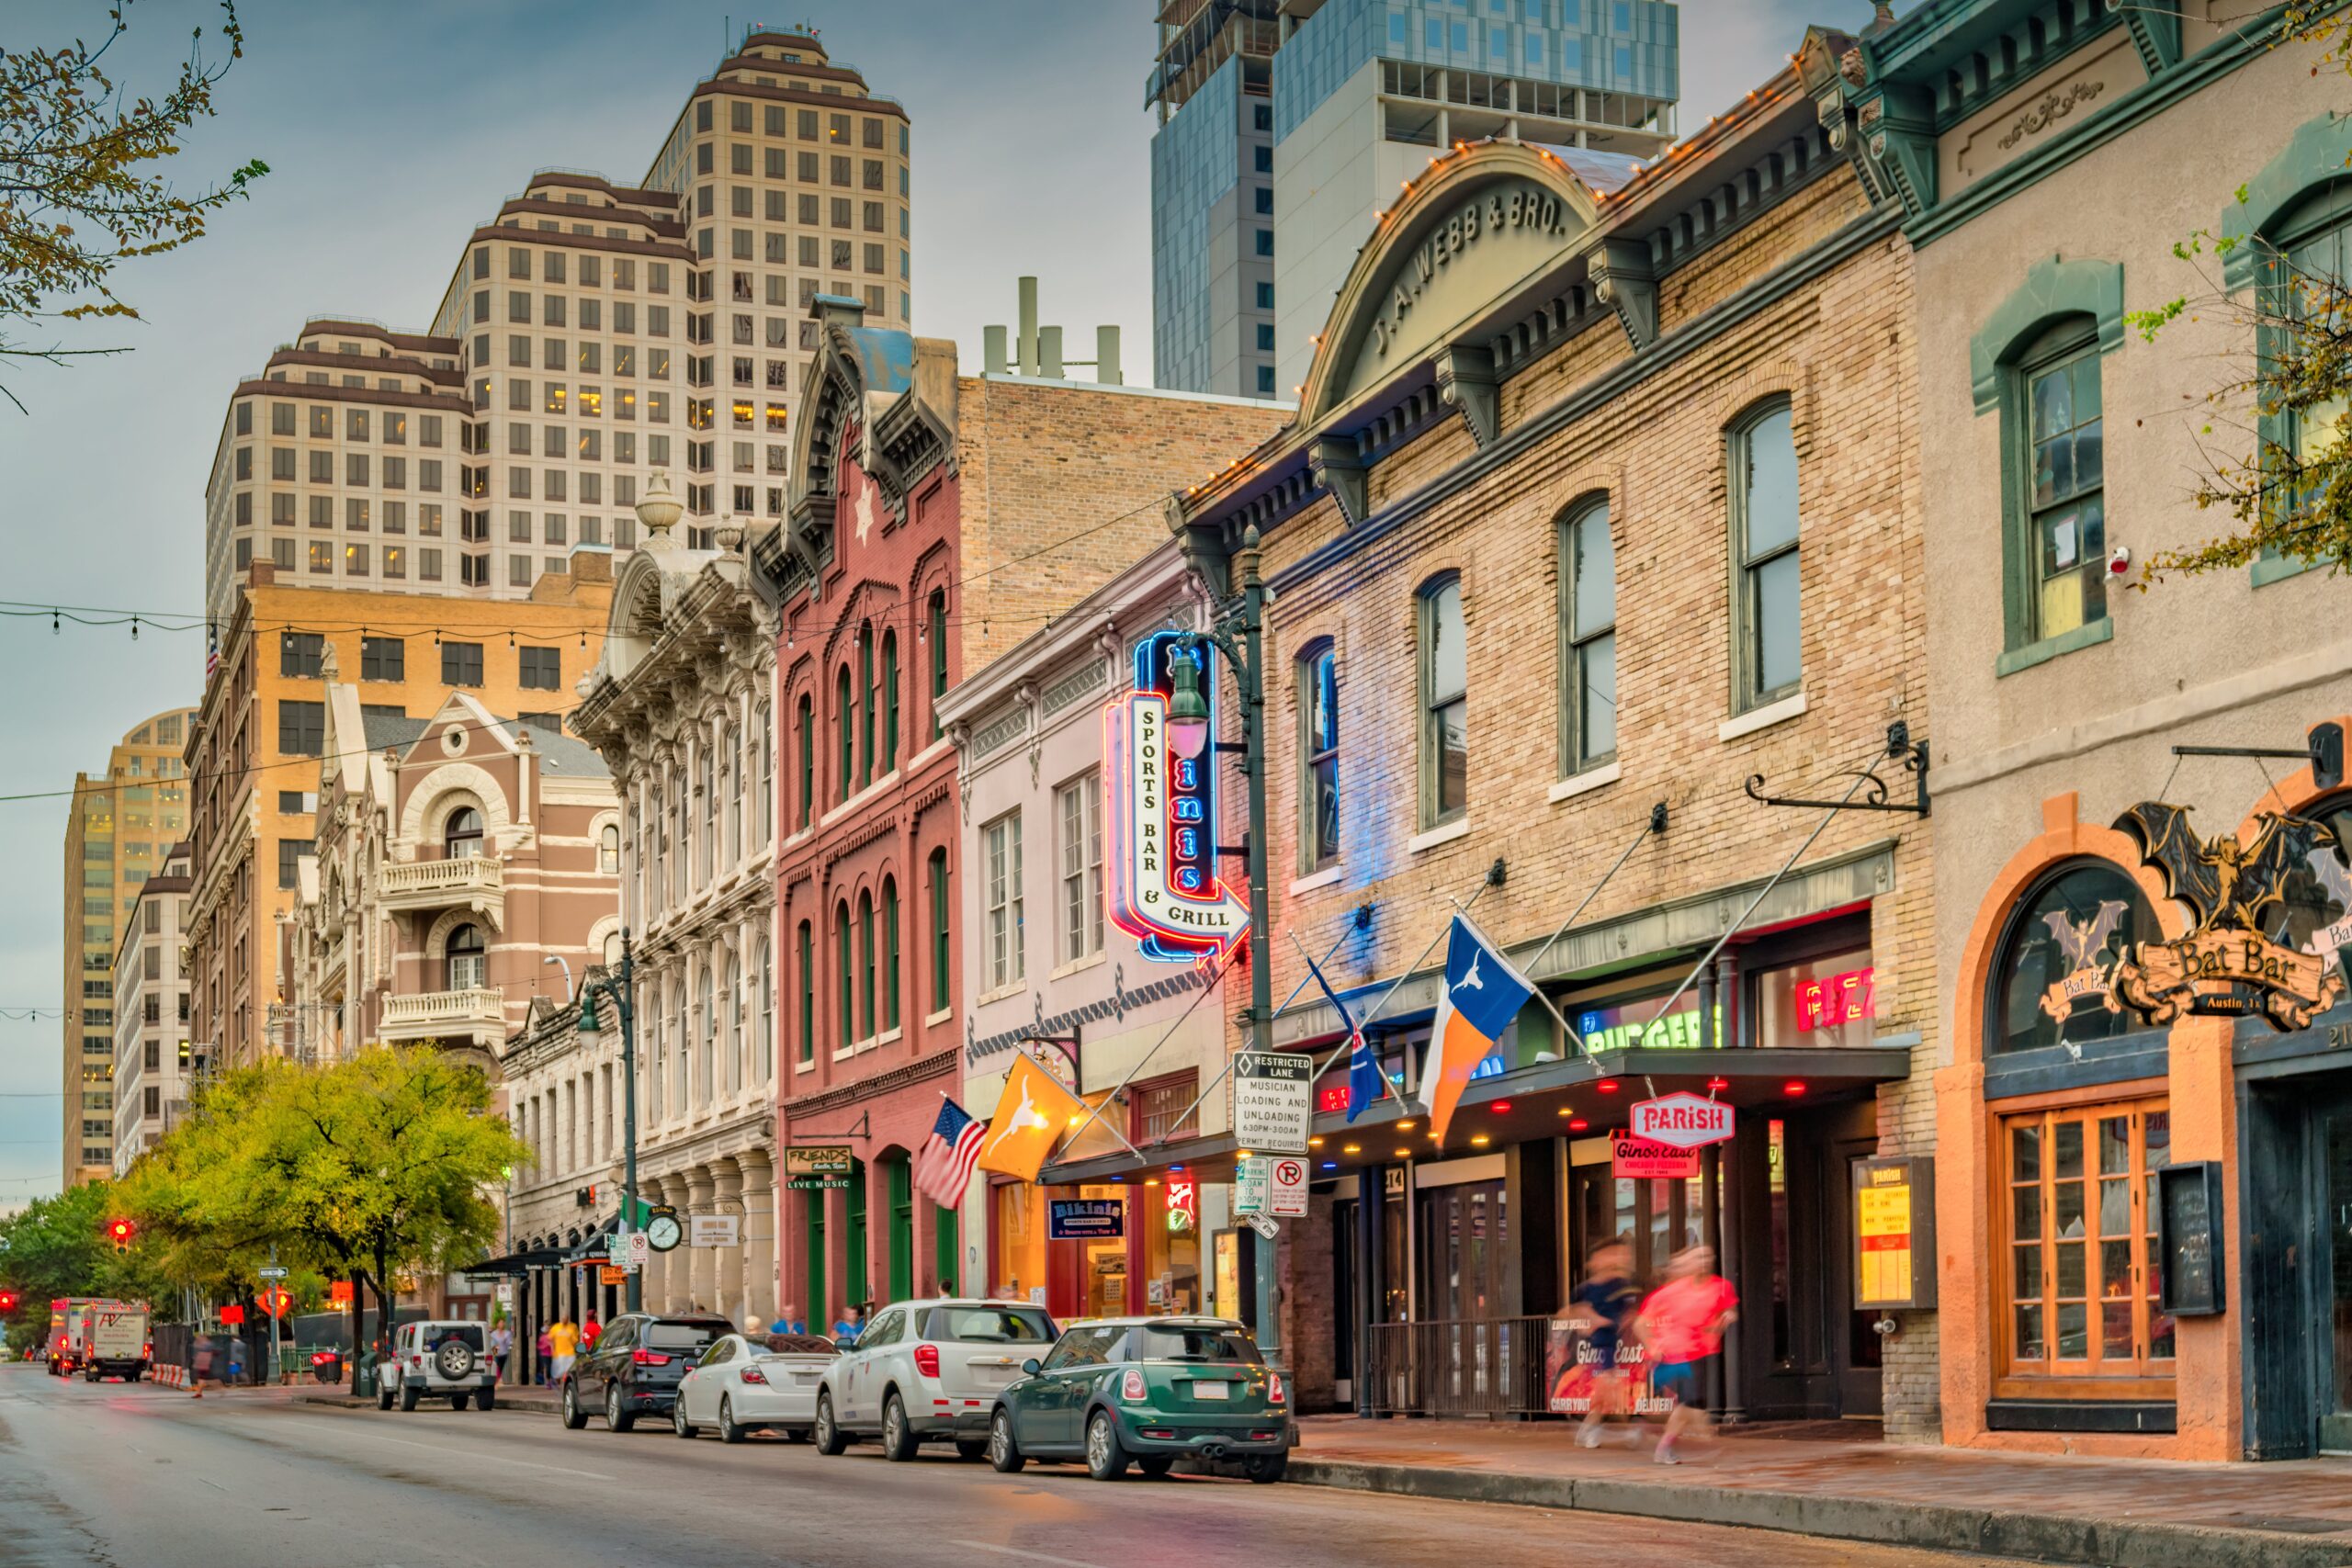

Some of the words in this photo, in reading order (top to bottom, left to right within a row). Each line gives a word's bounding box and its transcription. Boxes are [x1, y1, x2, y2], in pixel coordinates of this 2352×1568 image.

[1414, 204, 1481, 284] WEBB
[1487, 196, 1505, 230] &
[1508, 191, 1566, 235] BRO.
[1142, 710, 1157, 809] SPORTS
[1142, 823, 1158, 872] BAR
[1144, 889, 1159, 905] &
[1168, 905, 1230, 927] GRILL
[2178, 942, 2233, 978] Bat
[2239, 938, 2297, 985] Bar
[2064, 977, 2086, 998] Bat
[1586, 1010, 1722, 1054] BURGER
[2329, 1026, 2352, 1048] 21
[1254, 1056, 1310, 1069] RESTRICTED
[1270, 1067, 1295, 1078] LANE
[1250, 1081, 1296, 1093] MUSICIAN
[1237, 1096, 1282, 1107] LOADING
[1288, 1098, 1307, 1109] AND
[1243, 1110, 1301, 1123] UNLOADING
[1237, 1137, 1263, 1146] PERMIT
[1267, 1138, 1305, 1149] REQUIRED
[1617, 1142, 1659, 1158] Gino's
[787, 1180, 810, 1190] LIVE
[815, 1179, 850, 1189] MUSIC
[1054, 1201, 1121, 1219] Bikinis
[1613, 1339, 1645, 1364] East
[1550, 1397, 1591, 1412] CARRYOUT
